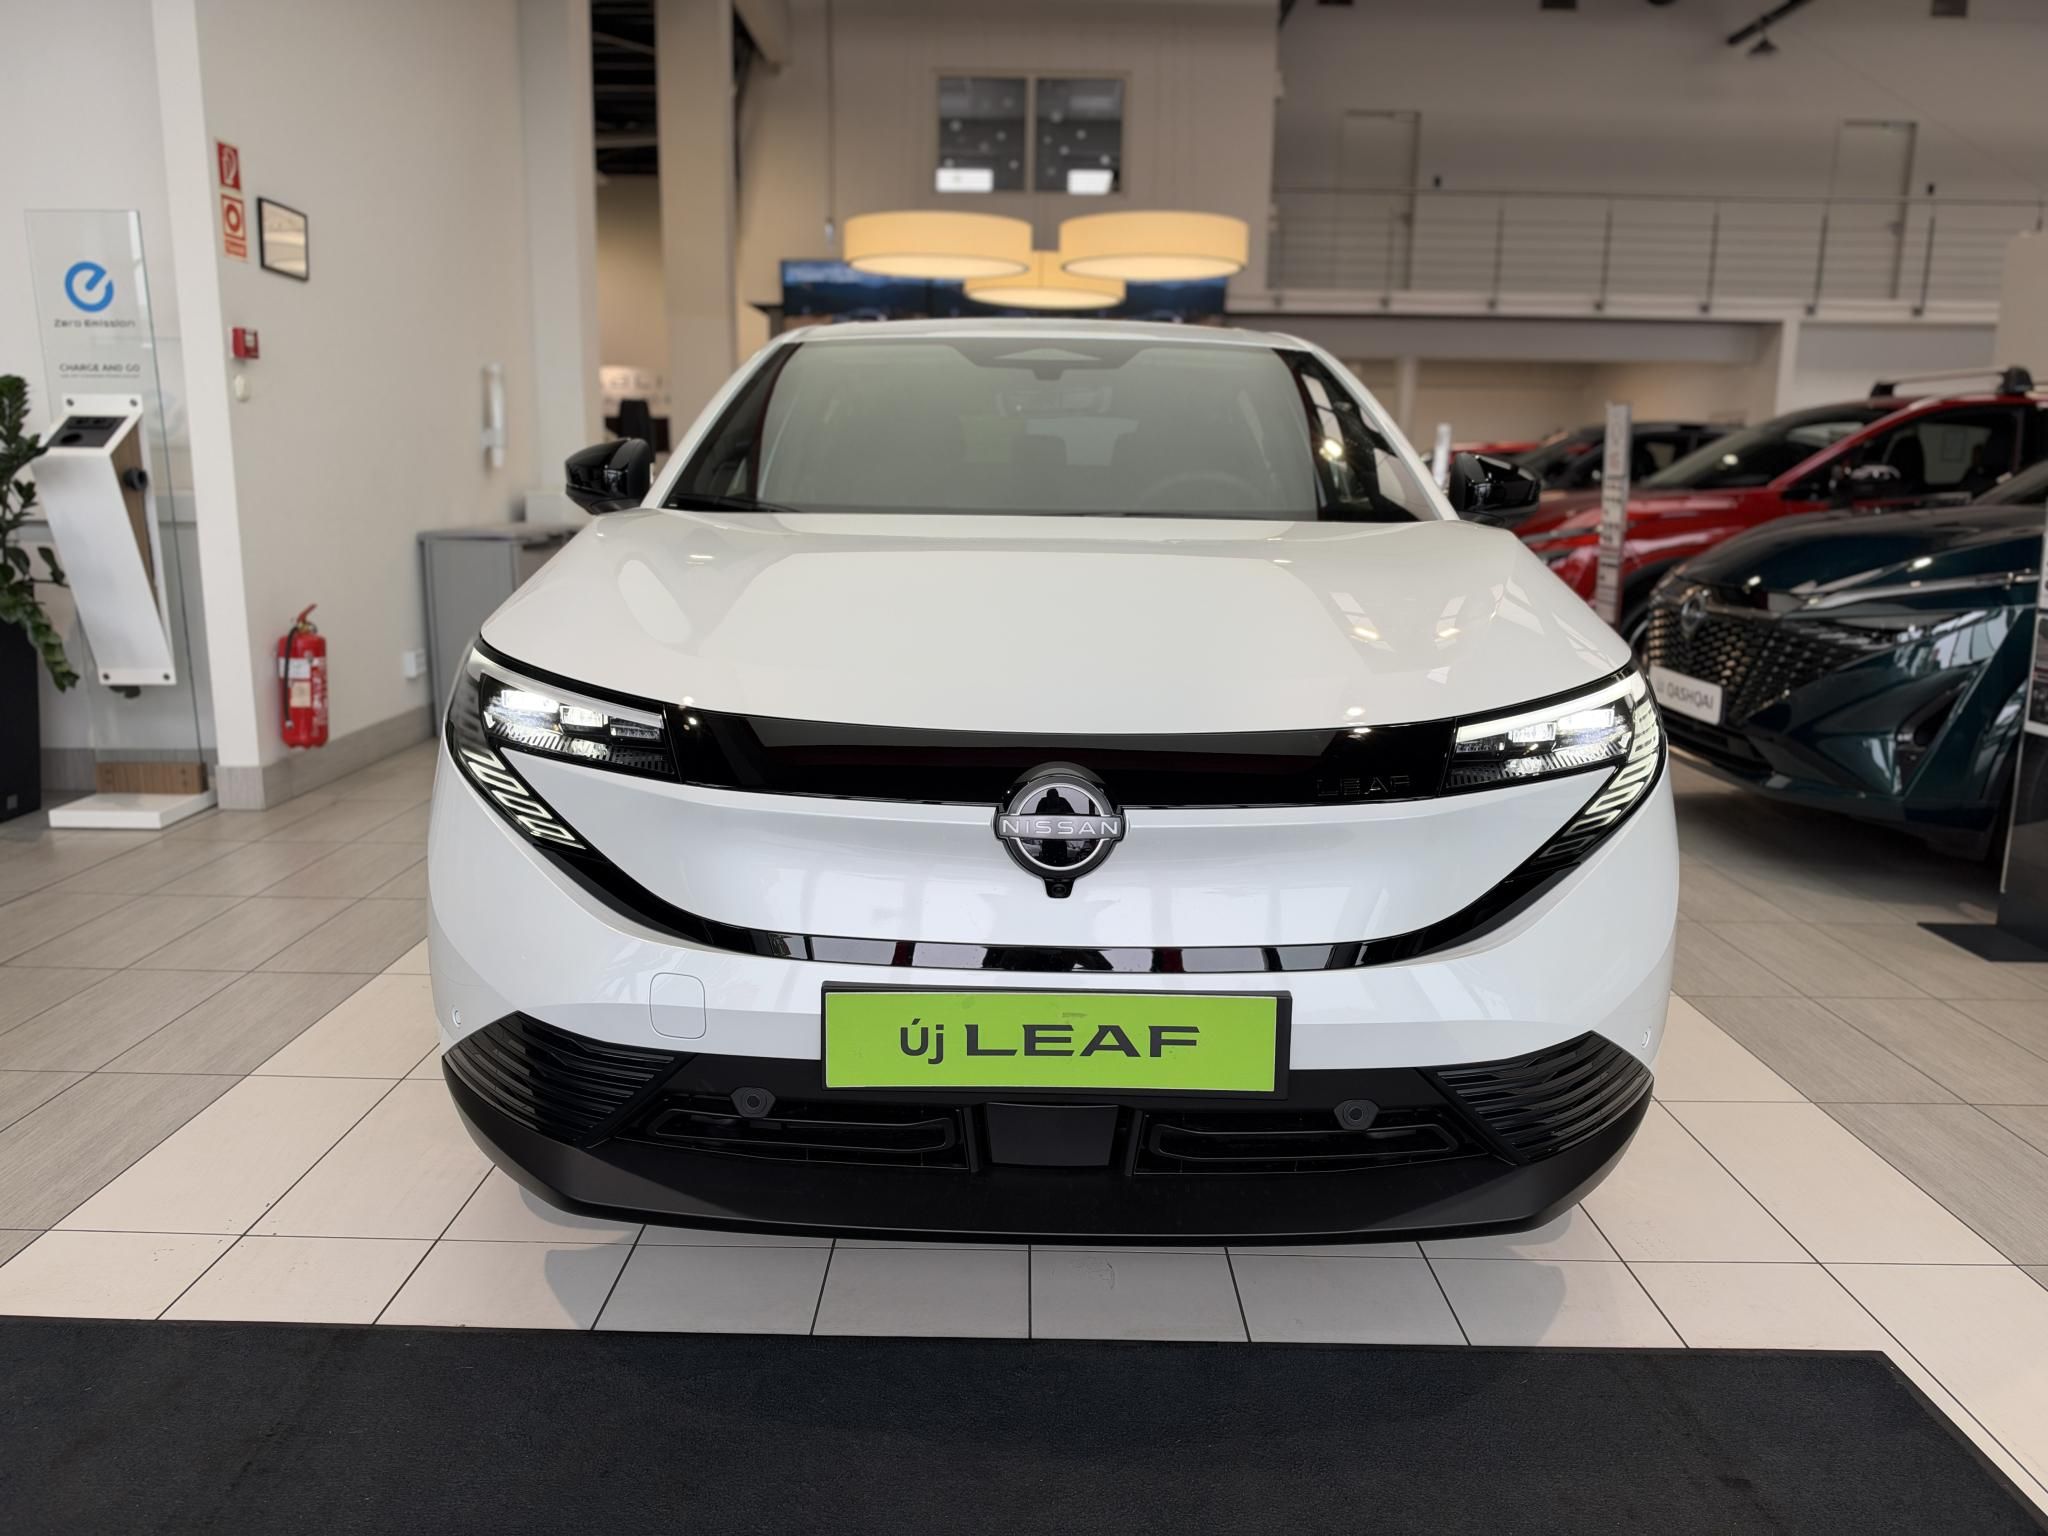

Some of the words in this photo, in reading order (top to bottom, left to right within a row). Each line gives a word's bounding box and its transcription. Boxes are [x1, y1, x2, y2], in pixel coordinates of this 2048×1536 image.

[54, 319, 82, 328] Zero
[84, 319, 136, 328] Emission
[60, 363, 99, 372] CHARGE
[102, 363, 124, 372] AND
[125, 363, 141, 372] GO
[1316, 775, 1410, 797] LEAF
[1002, 819, 1118, 835] NISSAN
[900, 1018, 945, 1065] Új
[965, 1023, 1201, 1058] LEAF
